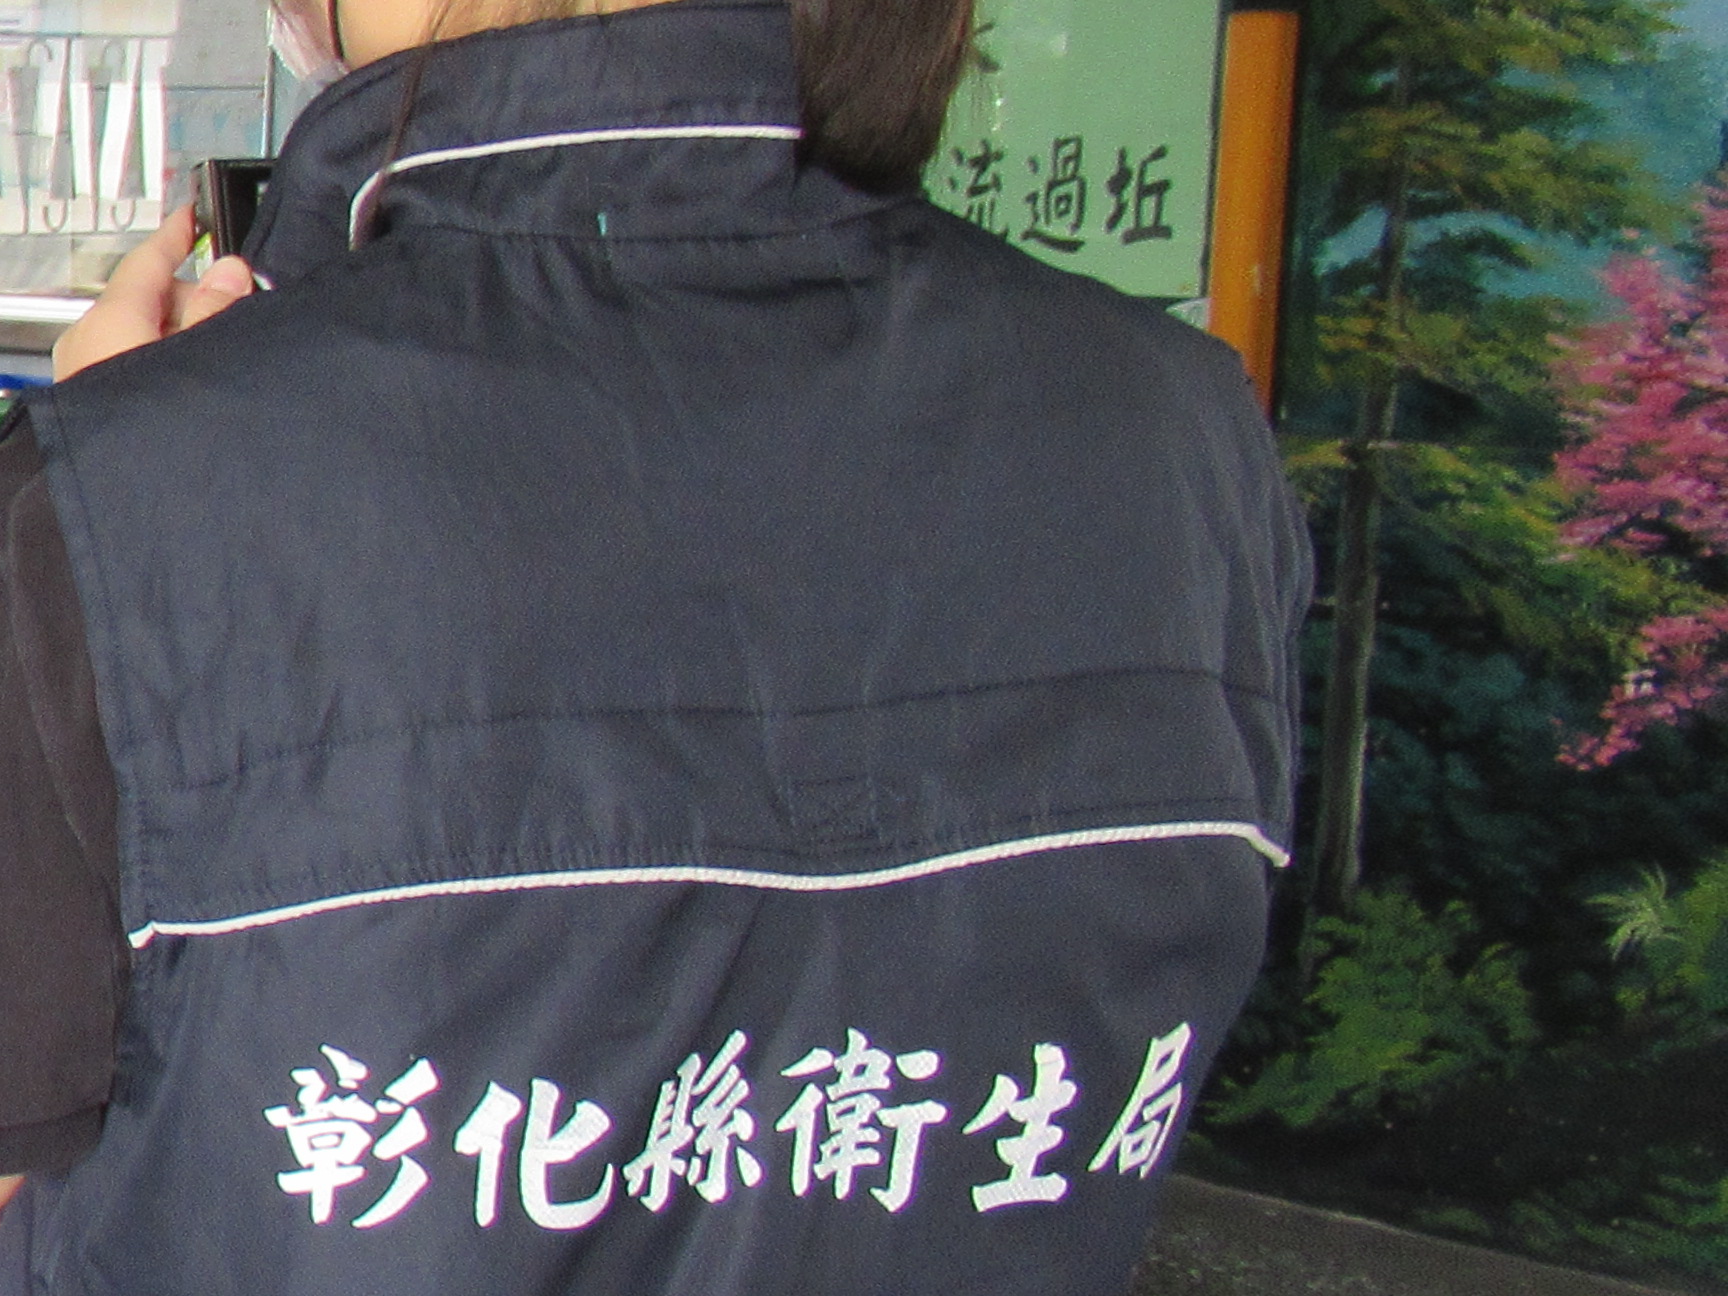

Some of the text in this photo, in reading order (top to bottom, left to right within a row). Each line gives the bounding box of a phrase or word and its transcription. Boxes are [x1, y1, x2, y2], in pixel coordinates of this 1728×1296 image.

[263, 1020, 1192, 1229] 彰化縣衛生局
